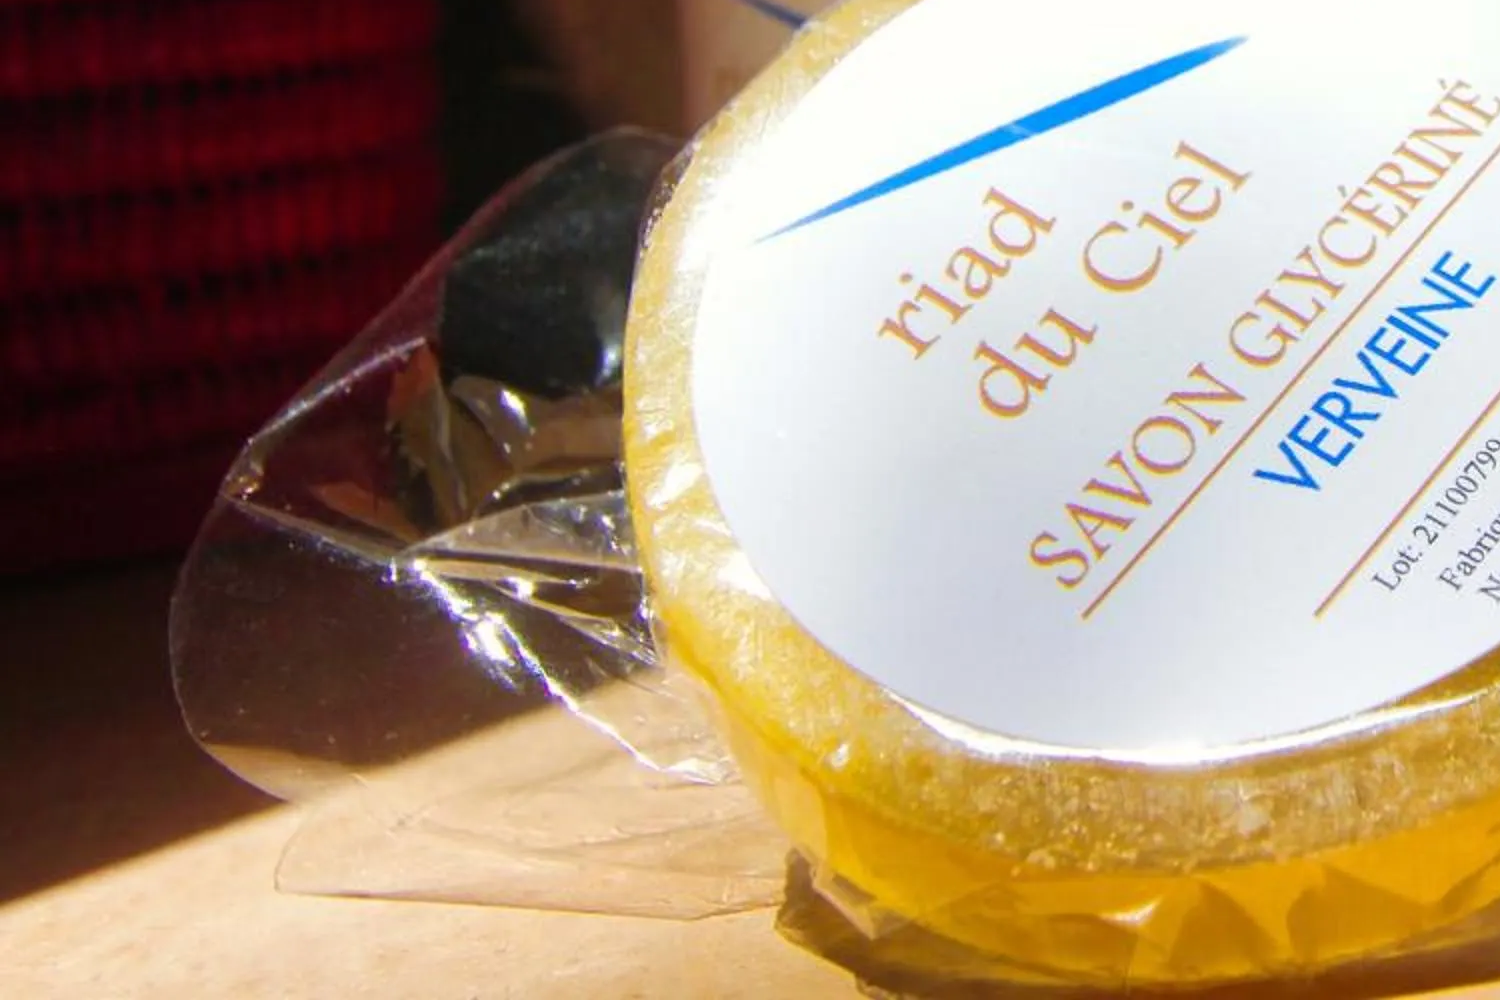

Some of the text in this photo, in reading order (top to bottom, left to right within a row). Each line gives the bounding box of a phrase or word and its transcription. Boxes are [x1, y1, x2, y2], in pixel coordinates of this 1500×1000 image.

[877, 187, 1056, 360] riad
[974, 140, 1252, 419] du Ciel
[1252, 250, 1496, 491] VERVEINE
[1029, 363, 1247, 589] SAVON
[1371, 545, 1424, 593] Lot:
